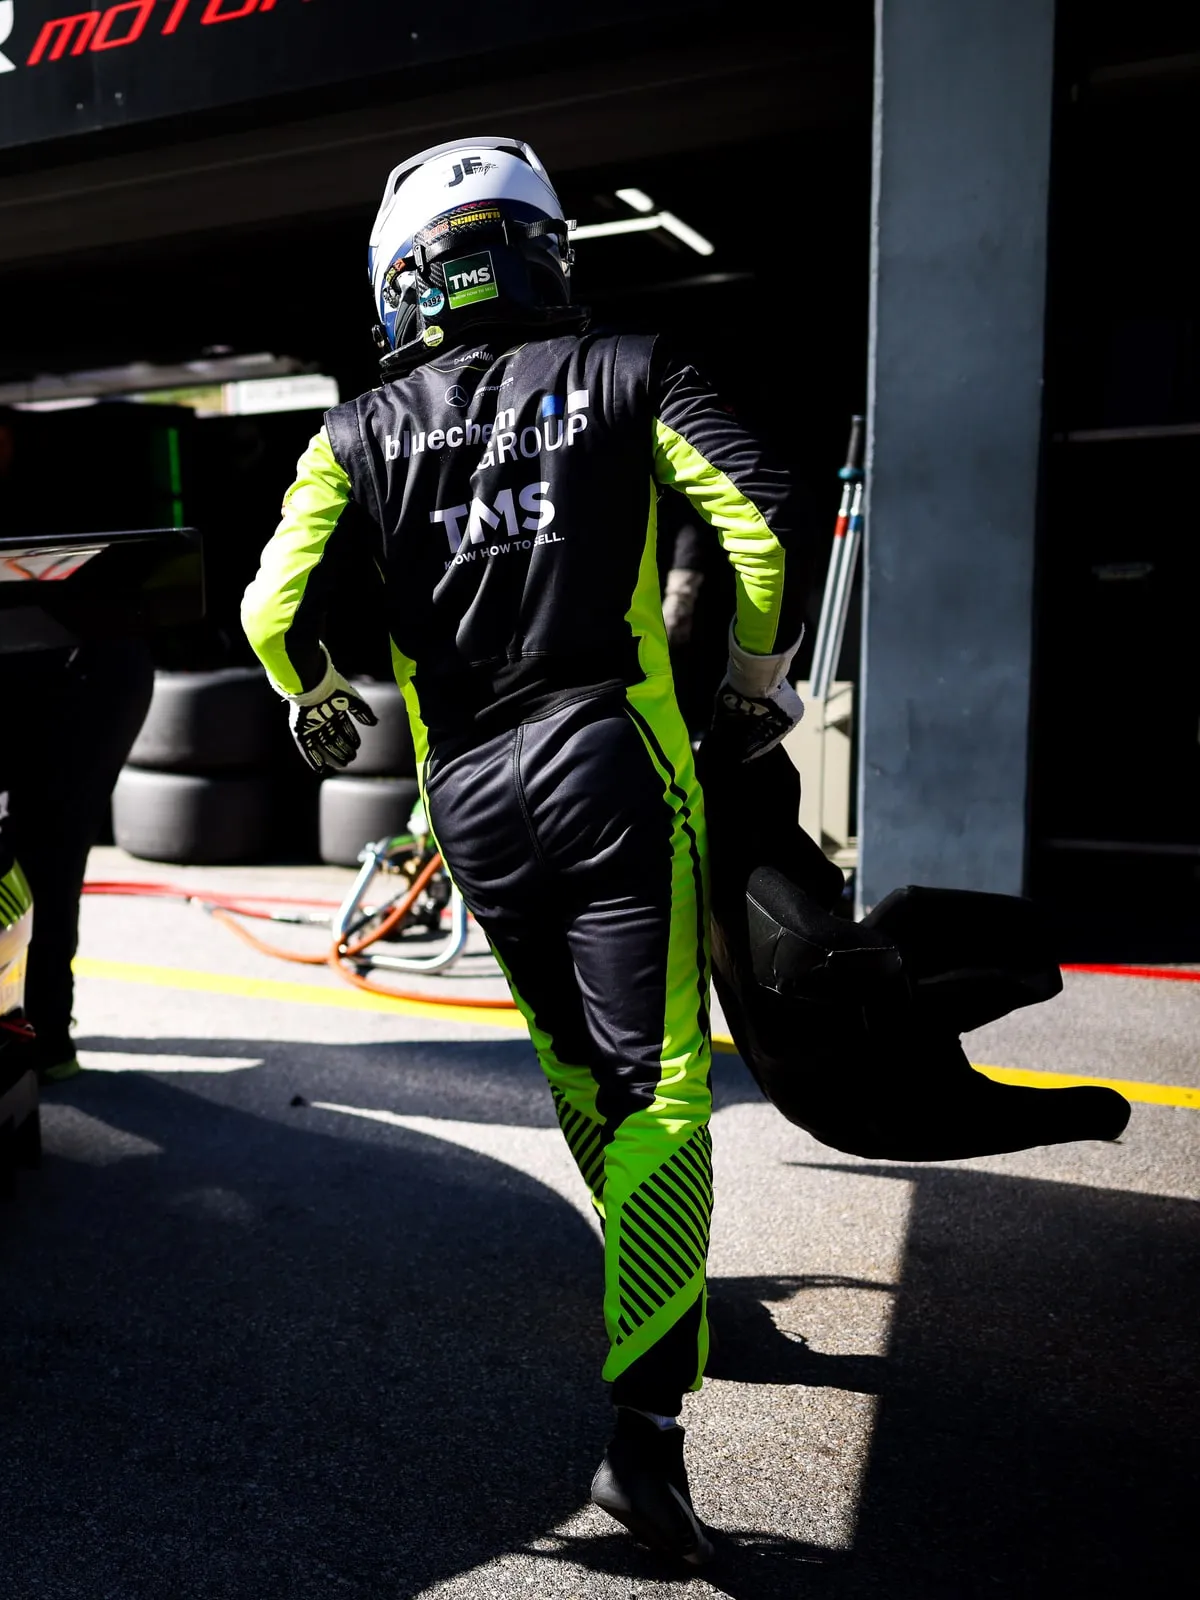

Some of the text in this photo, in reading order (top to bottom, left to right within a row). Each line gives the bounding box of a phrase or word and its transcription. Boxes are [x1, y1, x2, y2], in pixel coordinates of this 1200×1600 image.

[26, 0, 310, 66] MOTO
[449, 267, 491, 290] TMS
[385, 407, 516, 462] bluechem
[477, 413, 588, 471] GROUP
[429, 481, 555, 554] TMS
[480, 542, 511, 558] HOW
[513, 540, 531, 552] TO
